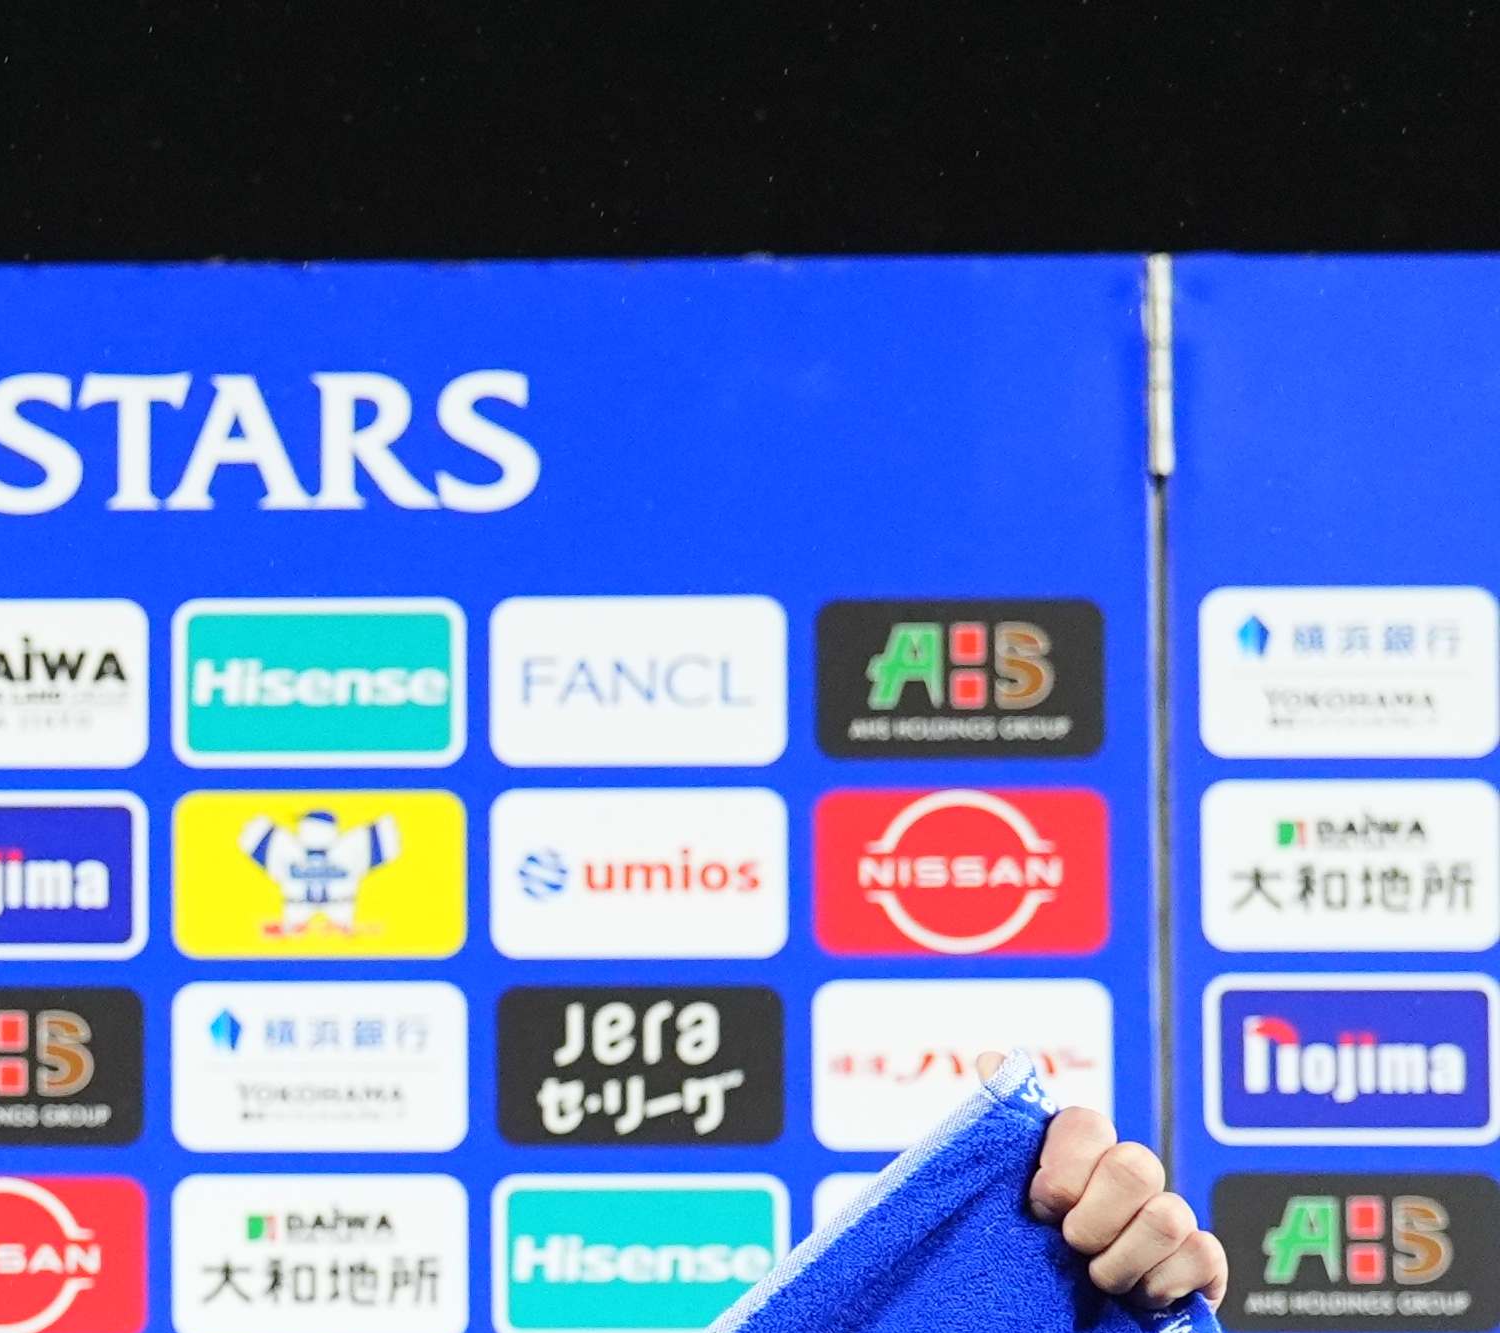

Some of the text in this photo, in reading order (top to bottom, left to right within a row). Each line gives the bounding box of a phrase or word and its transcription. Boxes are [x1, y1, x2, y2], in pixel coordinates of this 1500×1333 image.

[1292, 623, 1458, 655] 横浜銀行
[195, 662, 448, 704] Hisense
[519, 657, 751, 706] FANCL
[585, 849, 760, 891] umios
[859, 855, 1063, 887] NISSAN
[1236, 864, 1473, 910] 大和地所
[263, 1018, 426, 1049] 横浜銀行
[204, 1258, 439, 1305] 大和地所
